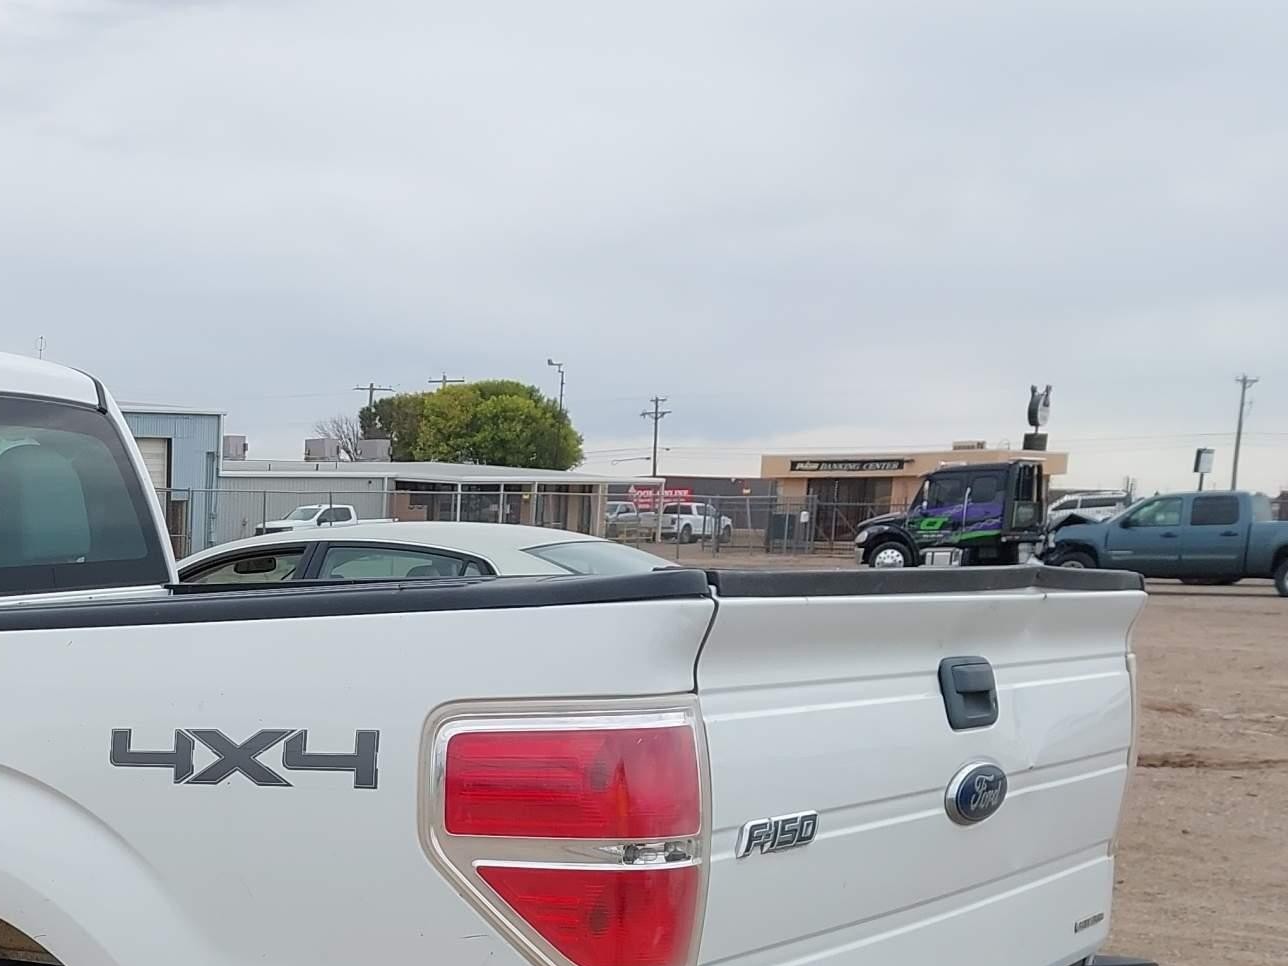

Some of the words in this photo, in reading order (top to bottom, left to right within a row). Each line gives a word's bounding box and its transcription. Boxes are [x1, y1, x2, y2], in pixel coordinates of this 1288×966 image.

[862, 461, 900, 471] CENTER
[970, 774, 1004, 811] Ford
[737, 810, 819, 858] F-150
